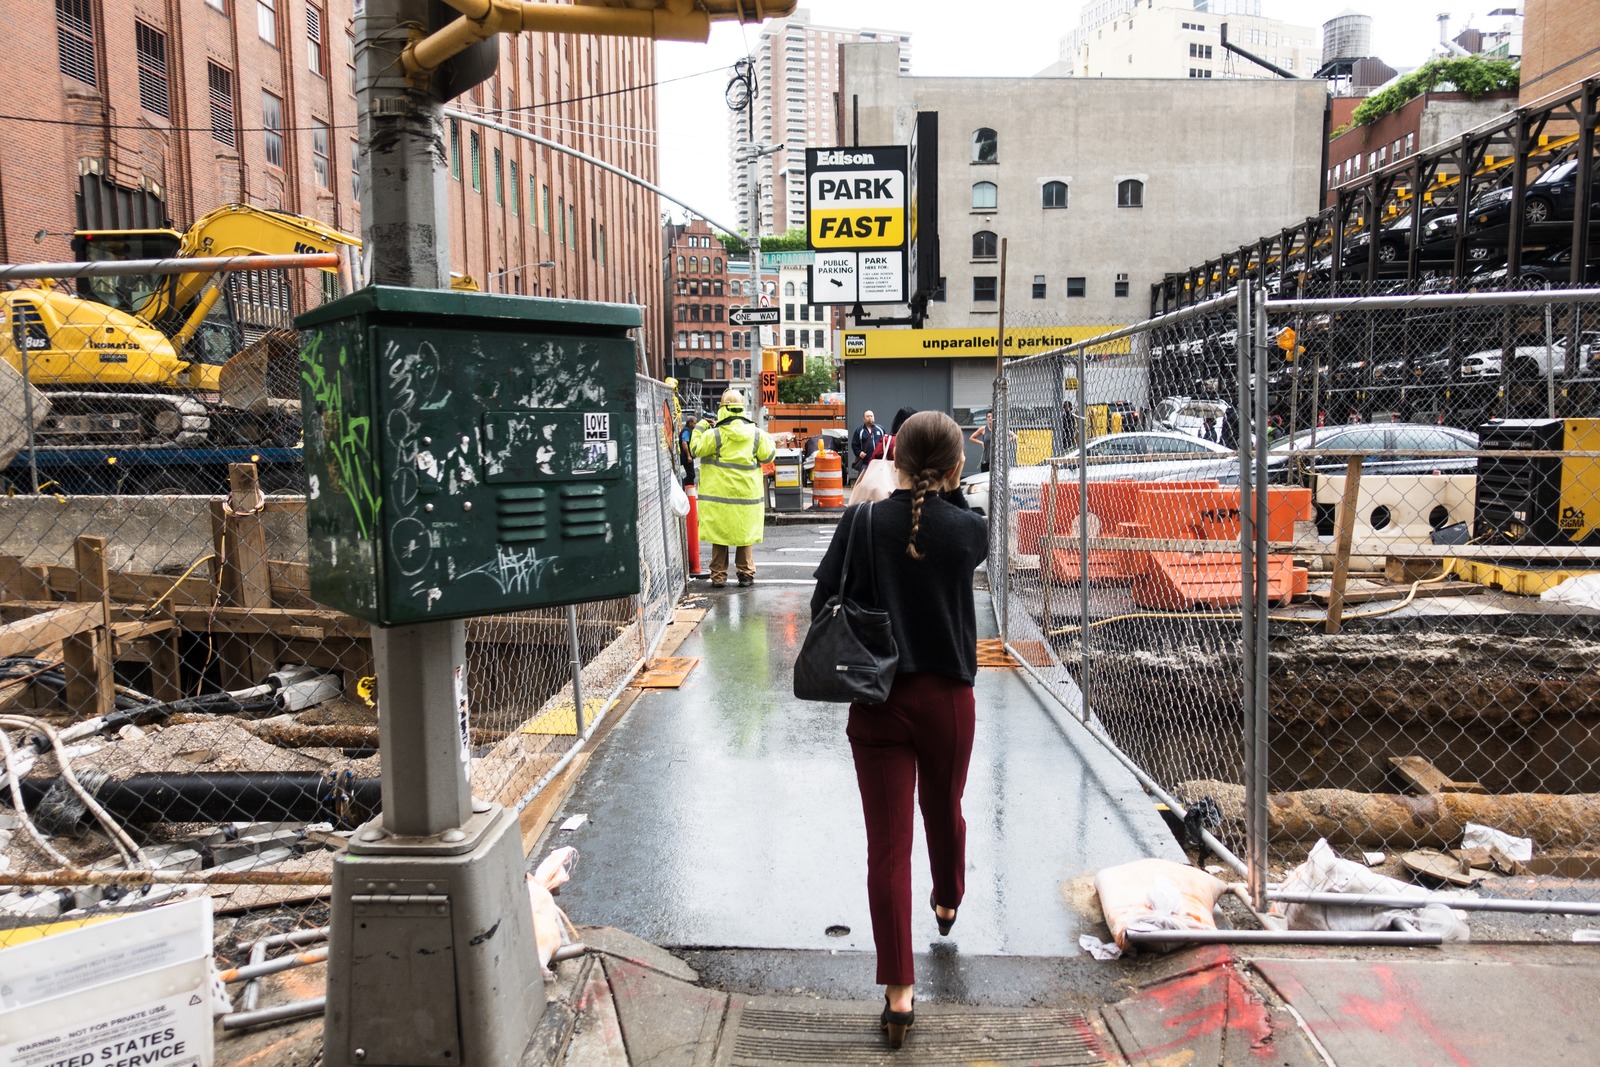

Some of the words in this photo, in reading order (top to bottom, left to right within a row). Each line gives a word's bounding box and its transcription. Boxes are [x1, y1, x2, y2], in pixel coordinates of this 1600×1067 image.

[817, 151, 875, 166] Edison
[818, 178, 894, 200] PARK
[819, 216, 892, 238] FAST
[764, 255, 769, 264] W
[772, 253, 814, 264] BROADWAY
[735, 313, 751, 321] ONE
[760, 312, 776, 320] WAY
[94, 341, 140, 350] KOMATSU
[1017, 335, 1073, 349] parking
[585, 415, 608, 430] LOVE
[586, 431, 608, 439] ME
[1560, 518, 1585, 528] SIGMA
[17, 1036, 61, 1053] WARNING
[69, 1028, 87, 1038] NOT
[90, 1022, 108, 1032] FOR
[110, 1010, 146, 1026] PRIVATE
[149, 1005, 167, 1015] USE
[101, 1028, 175, 1059] STATES
